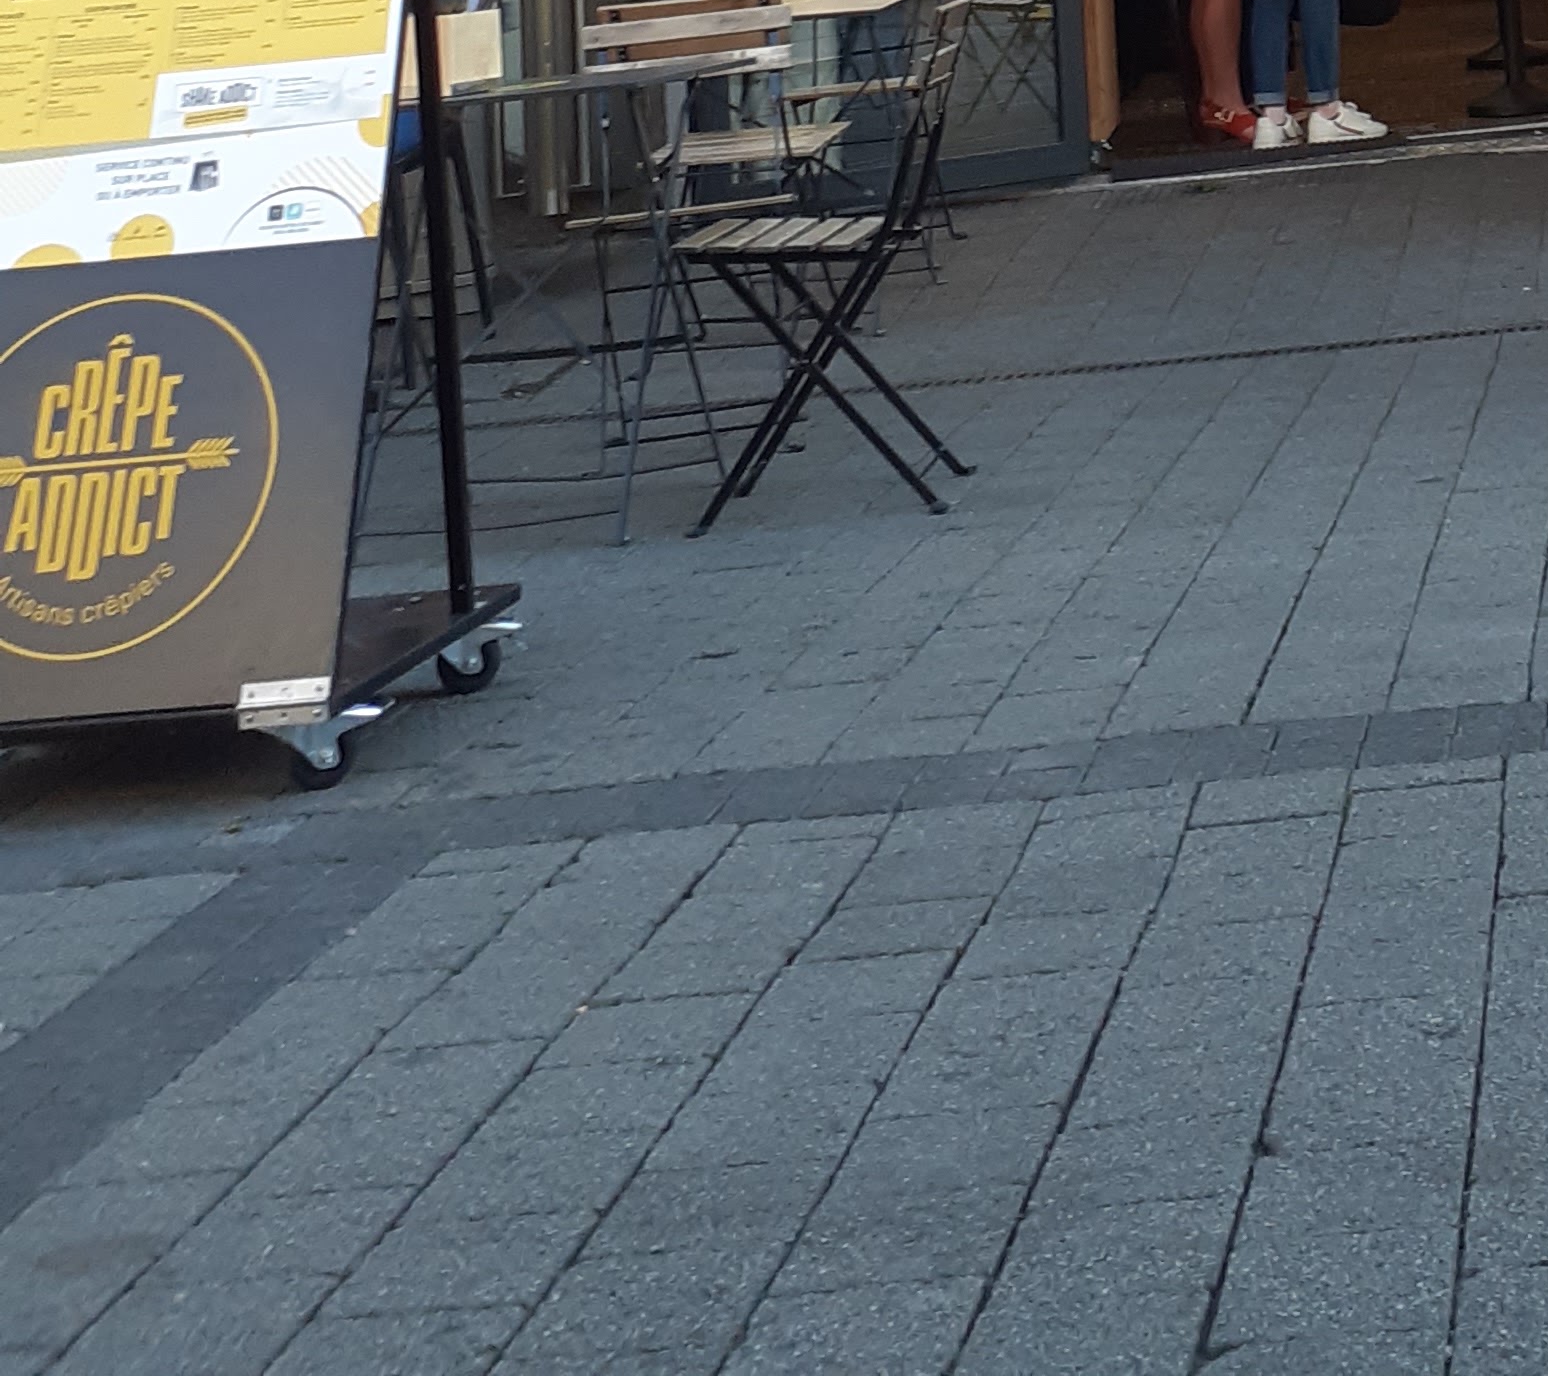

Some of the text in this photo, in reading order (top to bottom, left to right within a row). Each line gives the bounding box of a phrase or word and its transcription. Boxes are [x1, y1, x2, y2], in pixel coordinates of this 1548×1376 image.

[34, 333, 184, 460] CRÊPE
[4, 464, 188, 583] ADDICT
[79, 561, 176, 625] crêpiers
